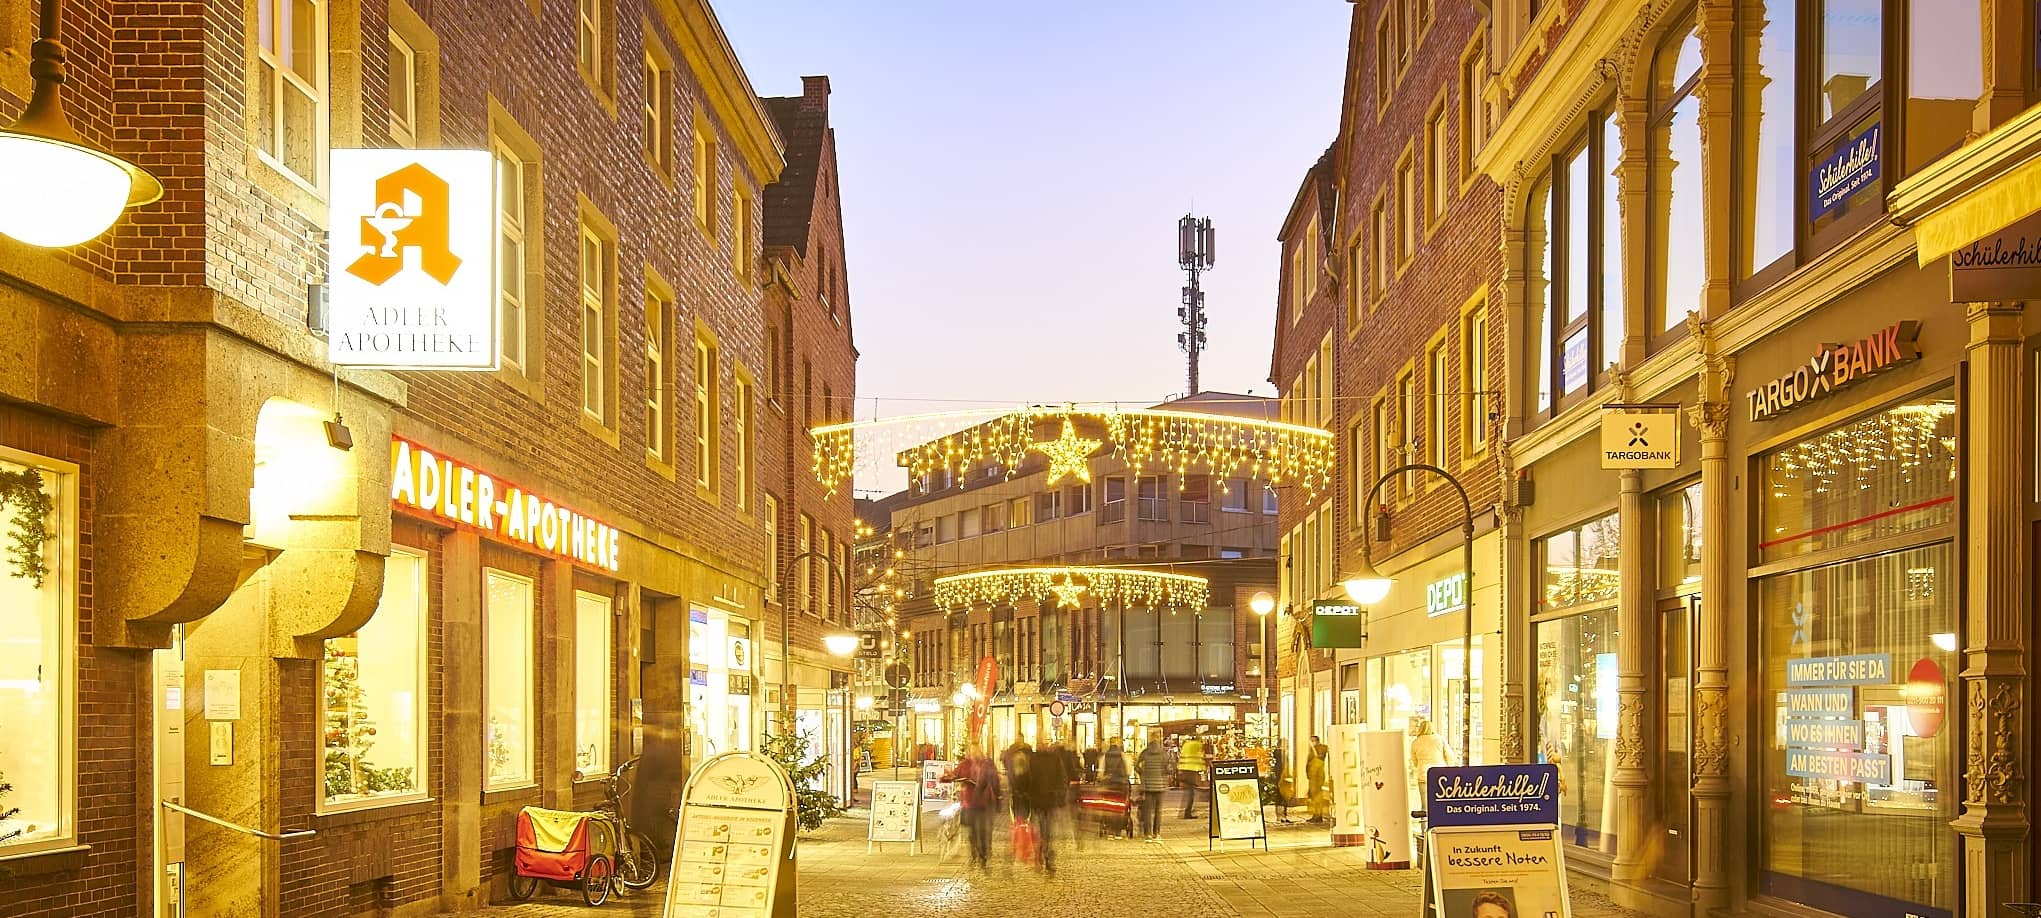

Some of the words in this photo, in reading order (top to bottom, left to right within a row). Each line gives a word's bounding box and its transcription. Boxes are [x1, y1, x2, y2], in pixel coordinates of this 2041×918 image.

[363, 306, 447, 327] ADLER
[338, 332, 480, 353] APOTHEKE
[1606, 451, 1671, 460] TARGOBANK
[391, 441, 619, 572] ADLER-APOTHEKE
[1315, 606, 1359, 616] DEPOT
[1791, 662, 1825, 682] IMMER
[1827, 657, 1847, 681] FÜR
[1849, 660, 1866, 680] SIE
[1868, 659, 1886, 679] DA
[1791, 694, 1823, 712] WANN
[1825, 693, 1848, 712] UND
[1791, 724, 1808, 741] WO
[1810, 725, 1823, 743] ES
[1824, 725, 1858, 744] IHNEN
[1215, 766, 1255, 775] DEPOT
[1790, 754, 1807, 772] AM
[1809, 755, 1848, 776] BESTEN
[1850, 760, 1886, 779] PASST
[1436, 772, 1550, 802] Schülerhilfe!
[1446, 805, 1462, 813] Das
[1464, 804, 1499, 815] Original.
[1501, 804, 1518, 812] Seit
[1519, 803, 1541, 812] 1974.
[1448, 855, 1503, 866] bessere
[1506, 852, 1548, 865] Noten
[1452, 846, 1462, 854] In
[1464, 845, 1502, 854] Zukunft
